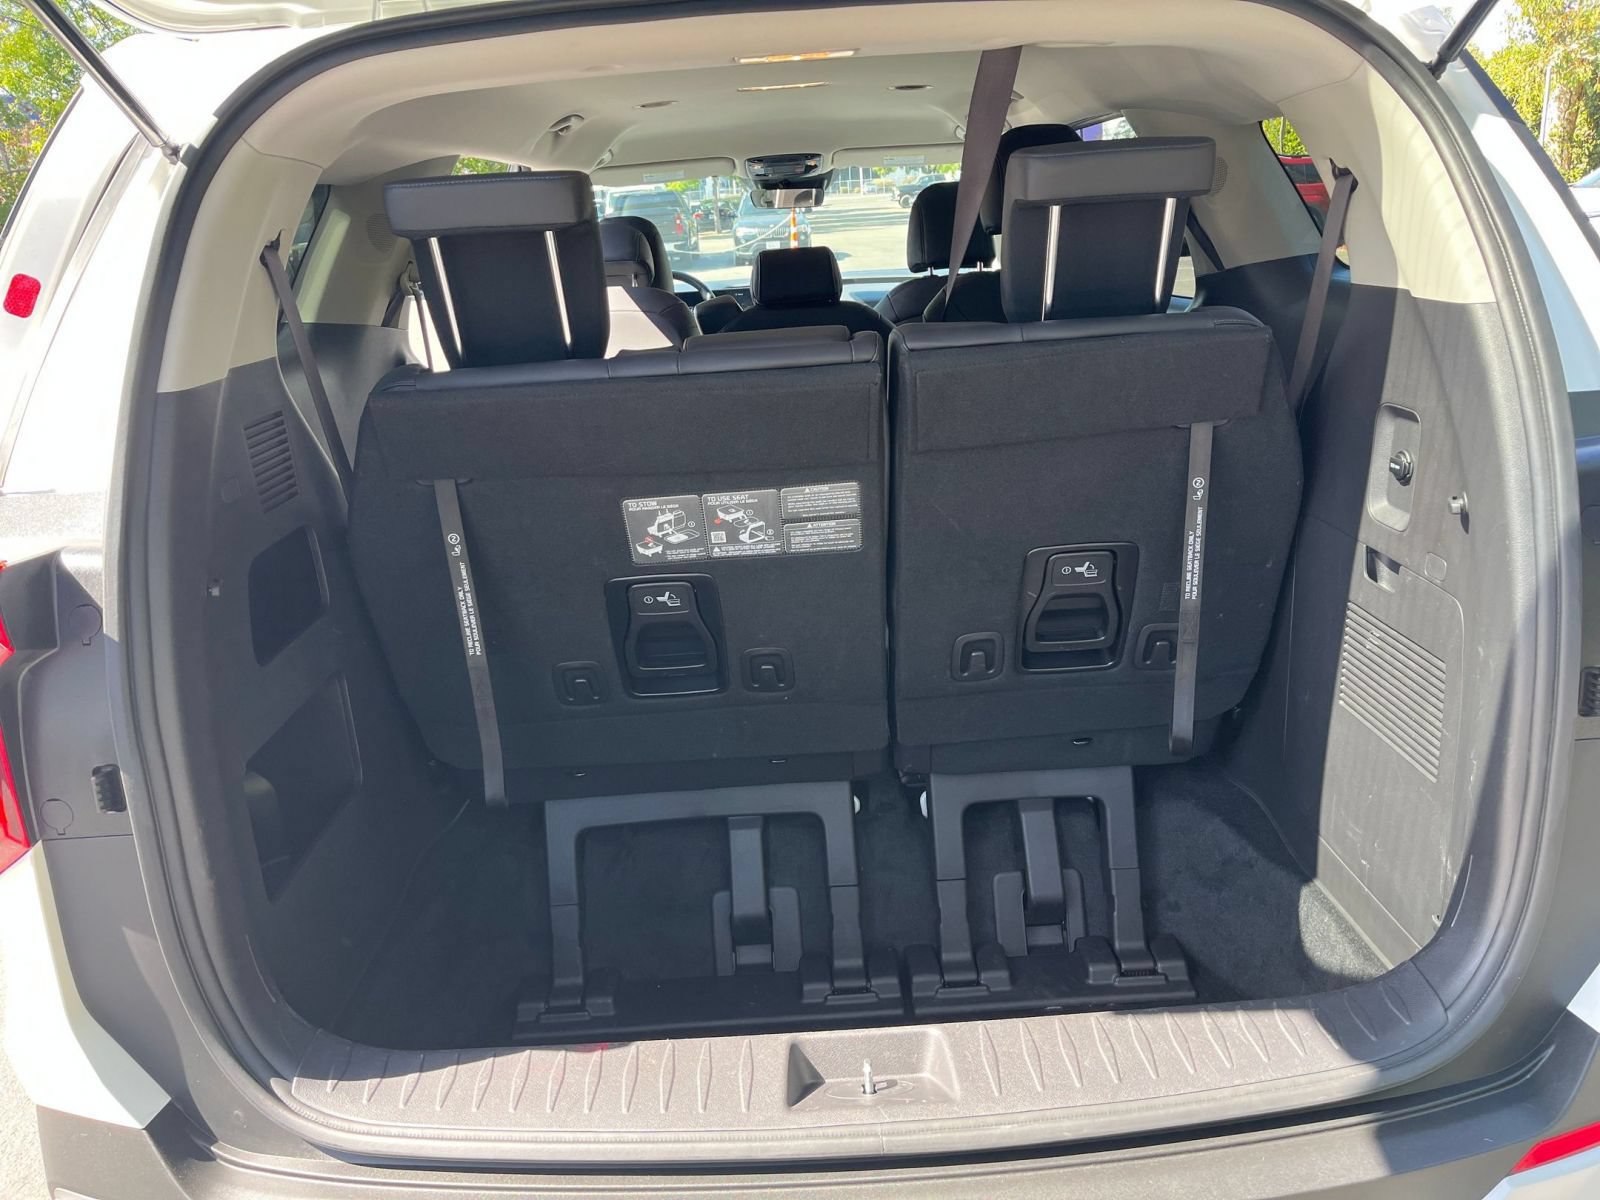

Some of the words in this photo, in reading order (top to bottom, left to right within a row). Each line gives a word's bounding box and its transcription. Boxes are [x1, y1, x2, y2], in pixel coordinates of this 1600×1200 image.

[460, 562, 470, 591] SEULEMENT
[461, 601, 469, 626] SEATBACK
[465, 628, 473, 647] RECLINE
[470, 615, 479, 640] SOULEVER
